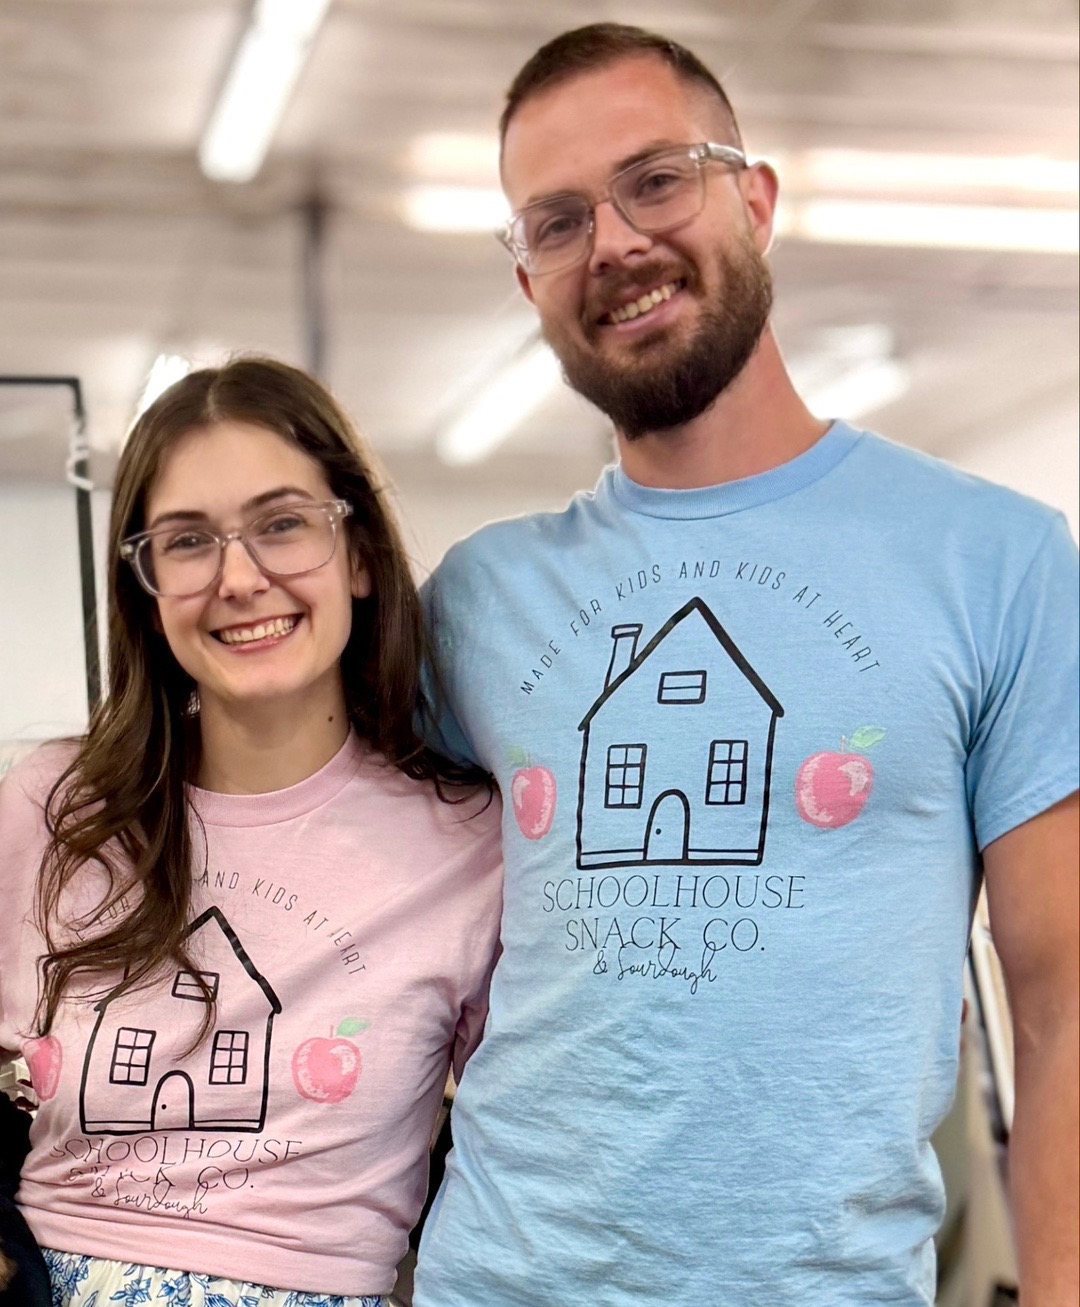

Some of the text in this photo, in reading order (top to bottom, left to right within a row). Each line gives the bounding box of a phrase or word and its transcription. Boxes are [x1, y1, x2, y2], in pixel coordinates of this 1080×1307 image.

[520, 559, 881, 695] MADE FOR KIDS AND KIDS AT HEART
[201, 871, 240, 890] AND
[252, 877, 298, 912] KIDS
[303, 910, 329, 931] AT
[542, 874, 806, 913] SCHOOLHOUSE
[564, 916, 766, 954] SNACK CO.
[591, 940, 717, 995] & Sourdough
[91, 1176, 208, 1218] & Sourdough
[197, 1166, 254, 1189] CO.
